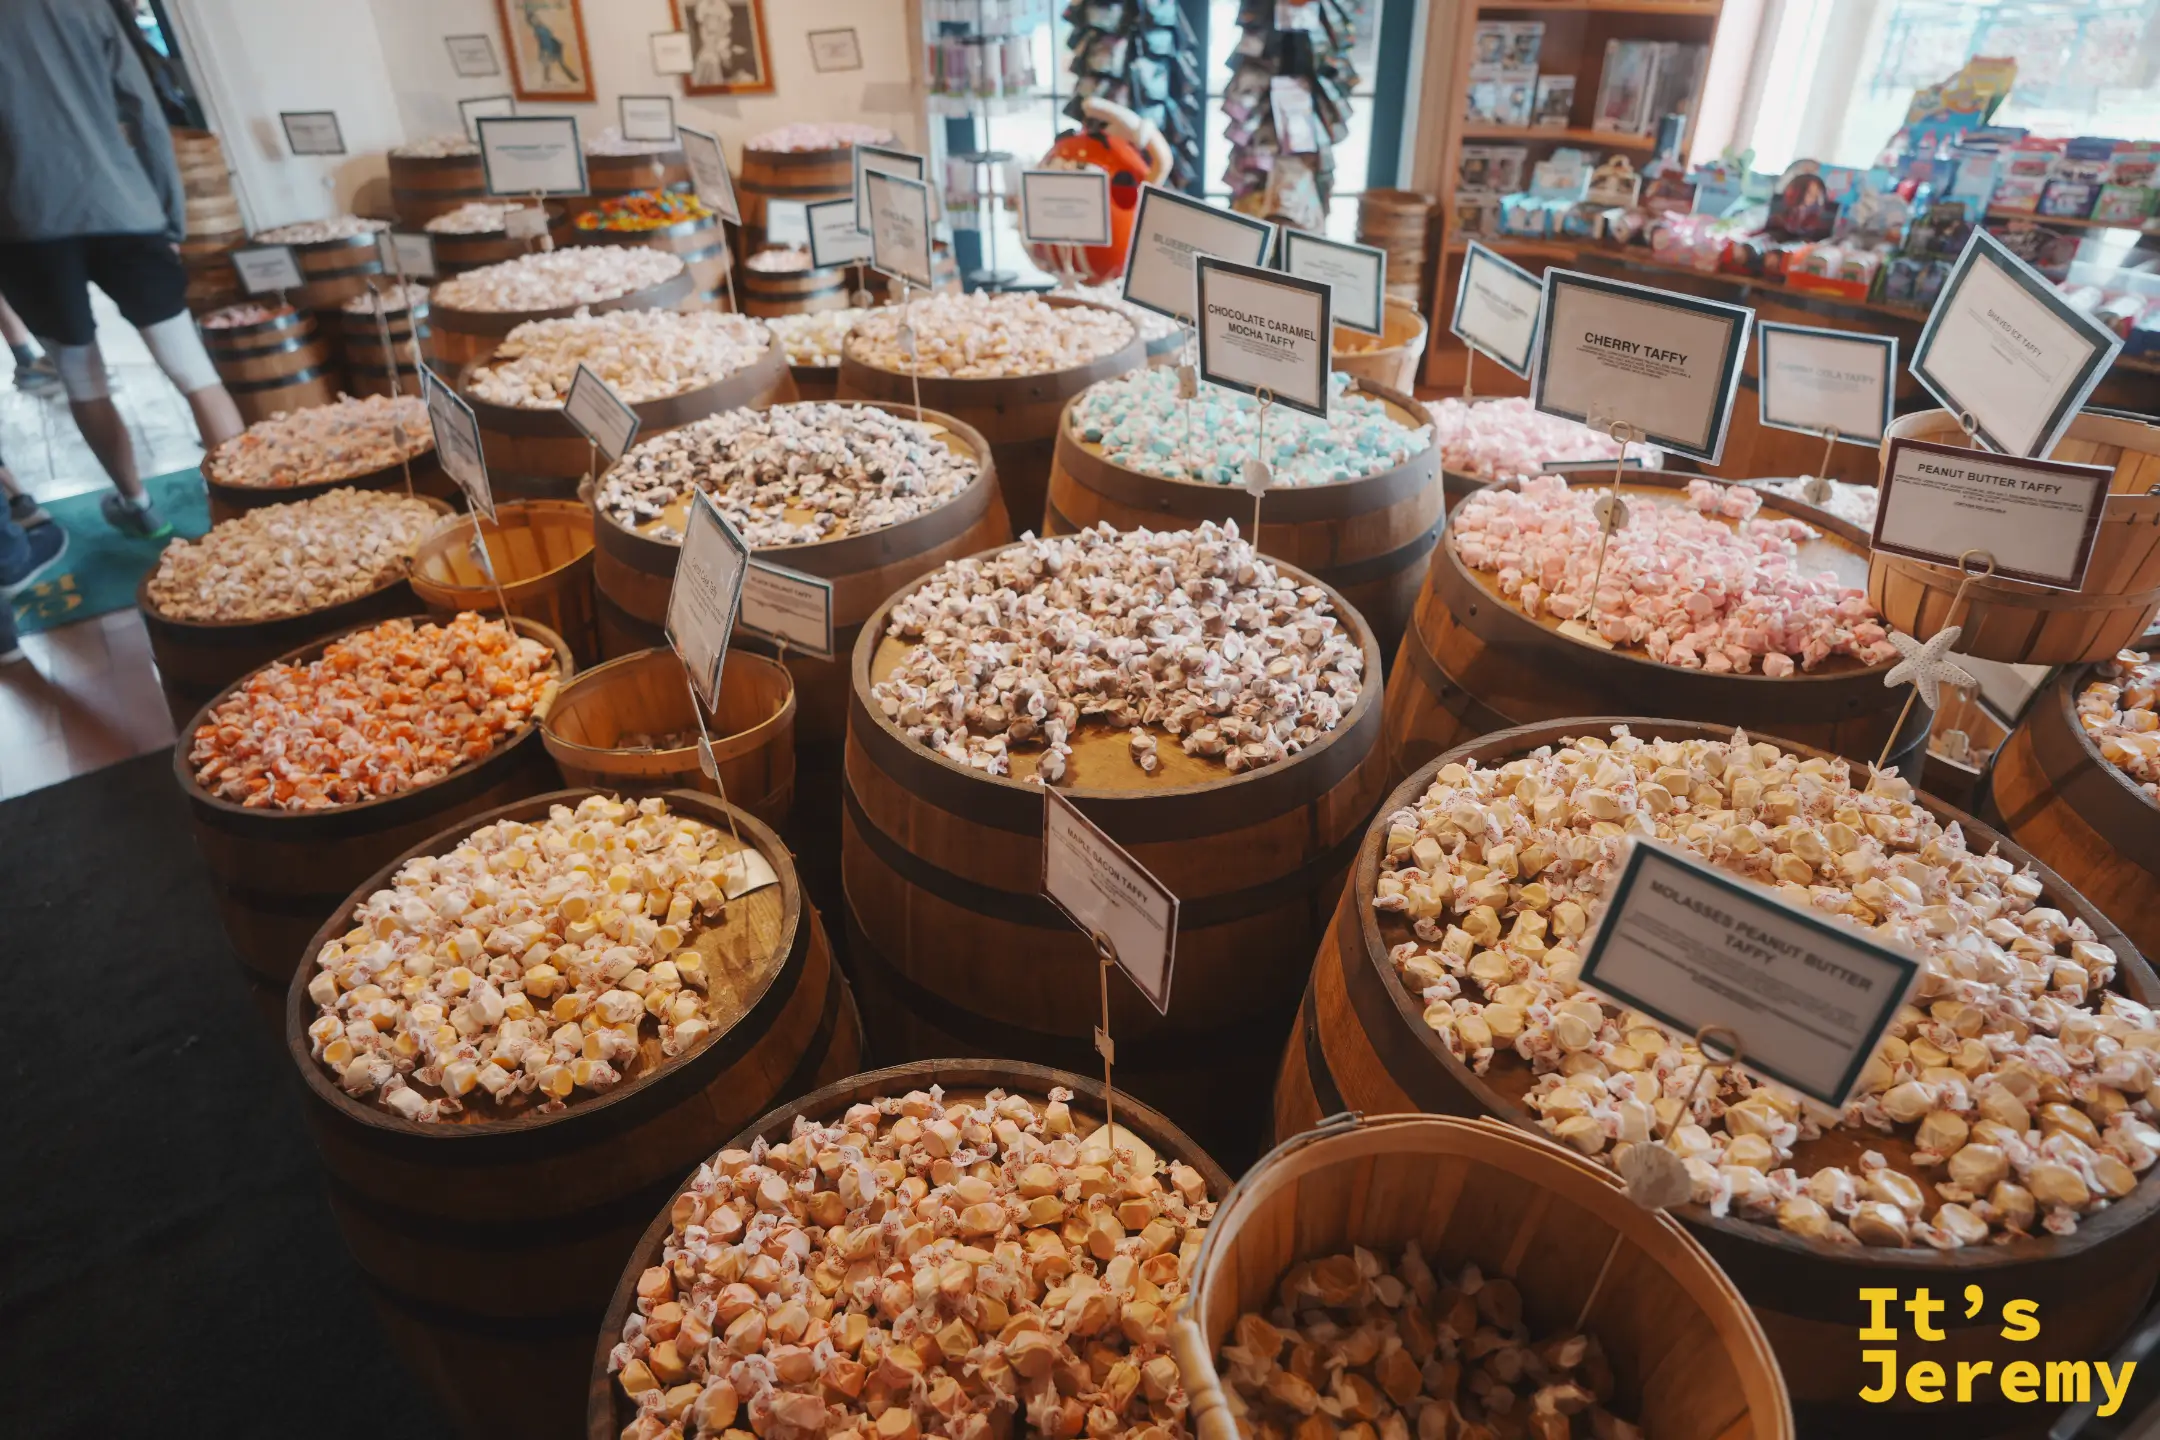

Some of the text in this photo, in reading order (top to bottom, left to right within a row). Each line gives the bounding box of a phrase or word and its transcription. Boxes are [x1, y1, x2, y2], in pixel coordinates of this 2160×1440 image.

[1208, 304, 1316, 341] CHOCOLATE CARAMEL
[1228, 322, 1263, 340] MOCHA
[1265, 332, 1295, 349] TAFFY
[1987, 308, 2012, 332] SHAVED
[2022, 338, 2043, 357] TAFFY
[1584, 332, 1640, 354] CHERRY
[1644, 345, 1688, 366] TAFFY
[1917, 463, 1964, 480] PEANUT
[1967, 472, 2016, 488] BUTTER
[2020, 480, 2063, 495] TAFFY
[1067, 827, 1148, 903] MAPLE BACON TAFFY
[1649, 880, 1873, 992] MOLASSES PEANUT BUTTER
[1723, 934, 1778, 965] TAFFY
